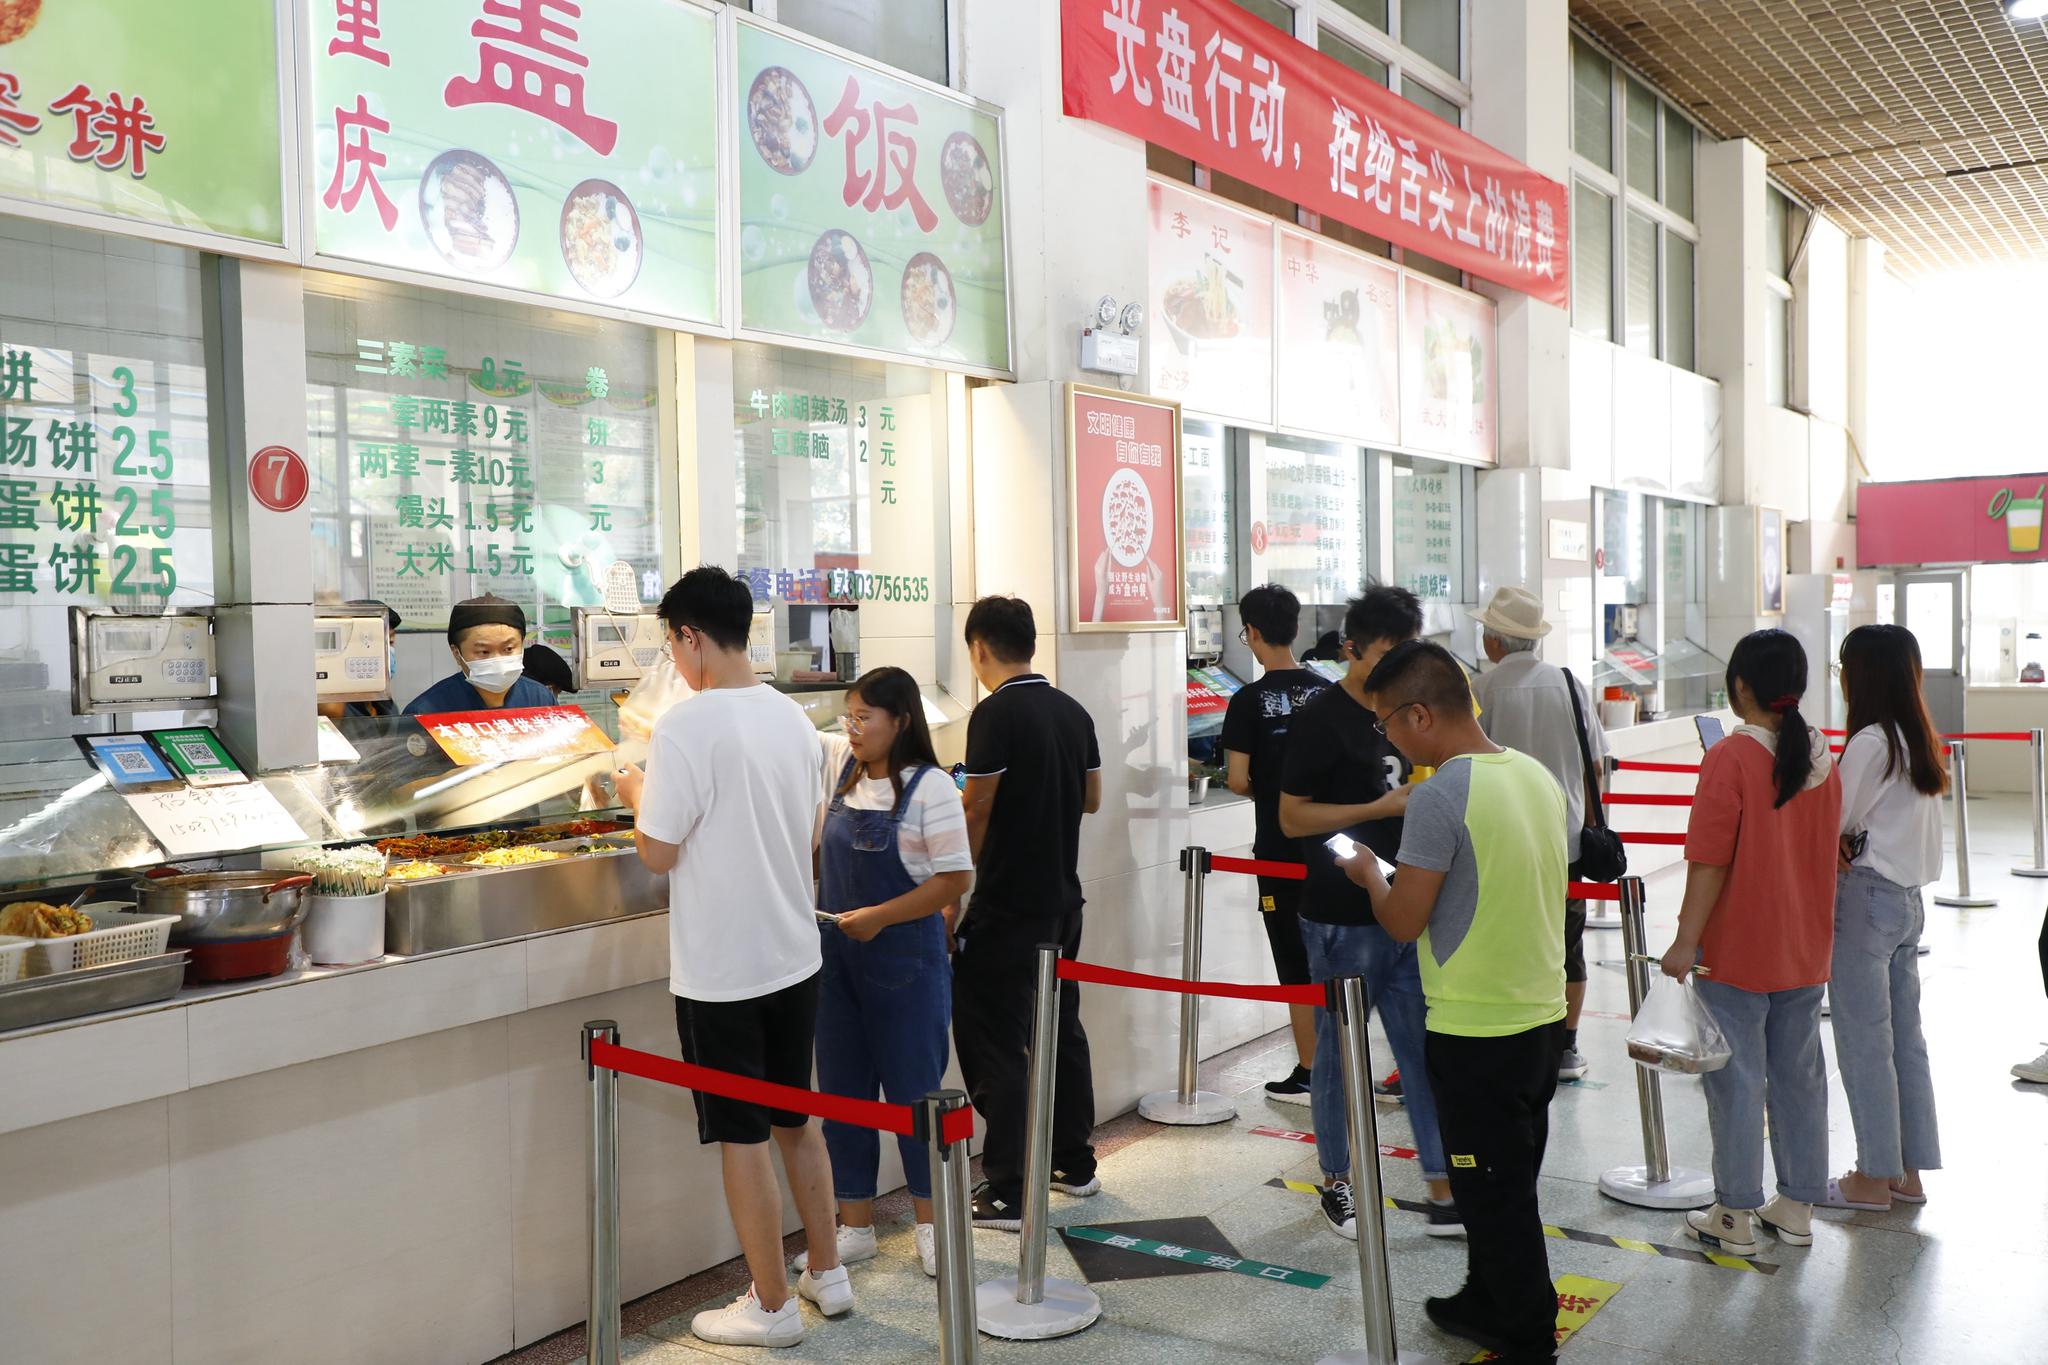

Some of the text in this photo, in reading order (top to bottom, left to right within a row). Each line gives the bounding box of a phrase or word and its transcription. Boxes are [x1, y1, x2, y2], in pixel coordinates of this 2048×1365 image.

[822, 74, 939, 233] 饭
[355, 338, 448, 381] 三素菜
[111, 366, 138, 418] 3
[111, 425, 174, 480] 2.5
[266, 455, 290, 501] 7
[112, 486, 175, 540] 2.5
[111, 544, 177, 597] 2.5
[737, 567, 822, 602] 餐电话
